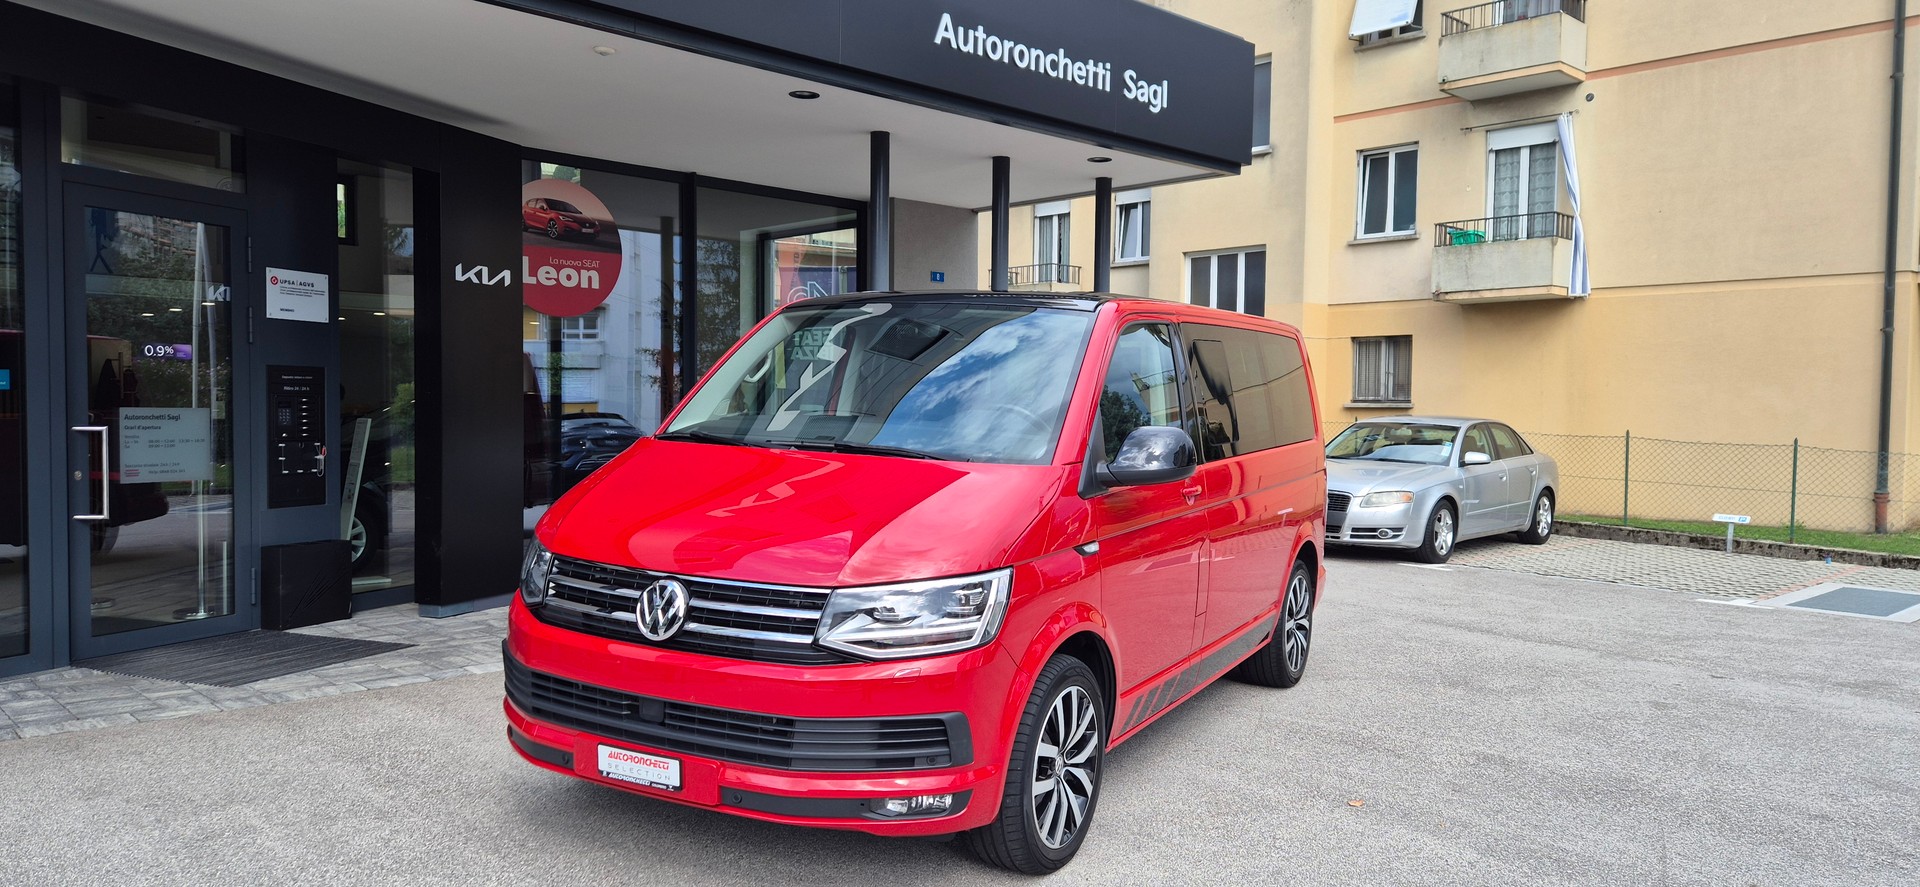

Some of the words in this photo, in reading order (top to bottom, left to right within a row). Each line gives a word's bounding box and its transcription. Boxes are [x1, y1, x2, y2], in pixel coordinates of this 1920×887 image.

[933, 12, 1111, 92] Autoronchetti
[1123, 69, 1168, 113] Sagl
[549, 256, 558, 265] La
[559, 258, 582, 267] nuova
[583, 259, 600, 268] SEAT
[522, 255, 600, 290] Leon
[279, 279, 296, 287] UPSA
[144, 344, 175, 357] 0.9%
[167, 414, 181, 422] Sagl
[608, 750, 670, 771] AUTORONCHETTI
[607, 763, 671, 781] SELECTION
